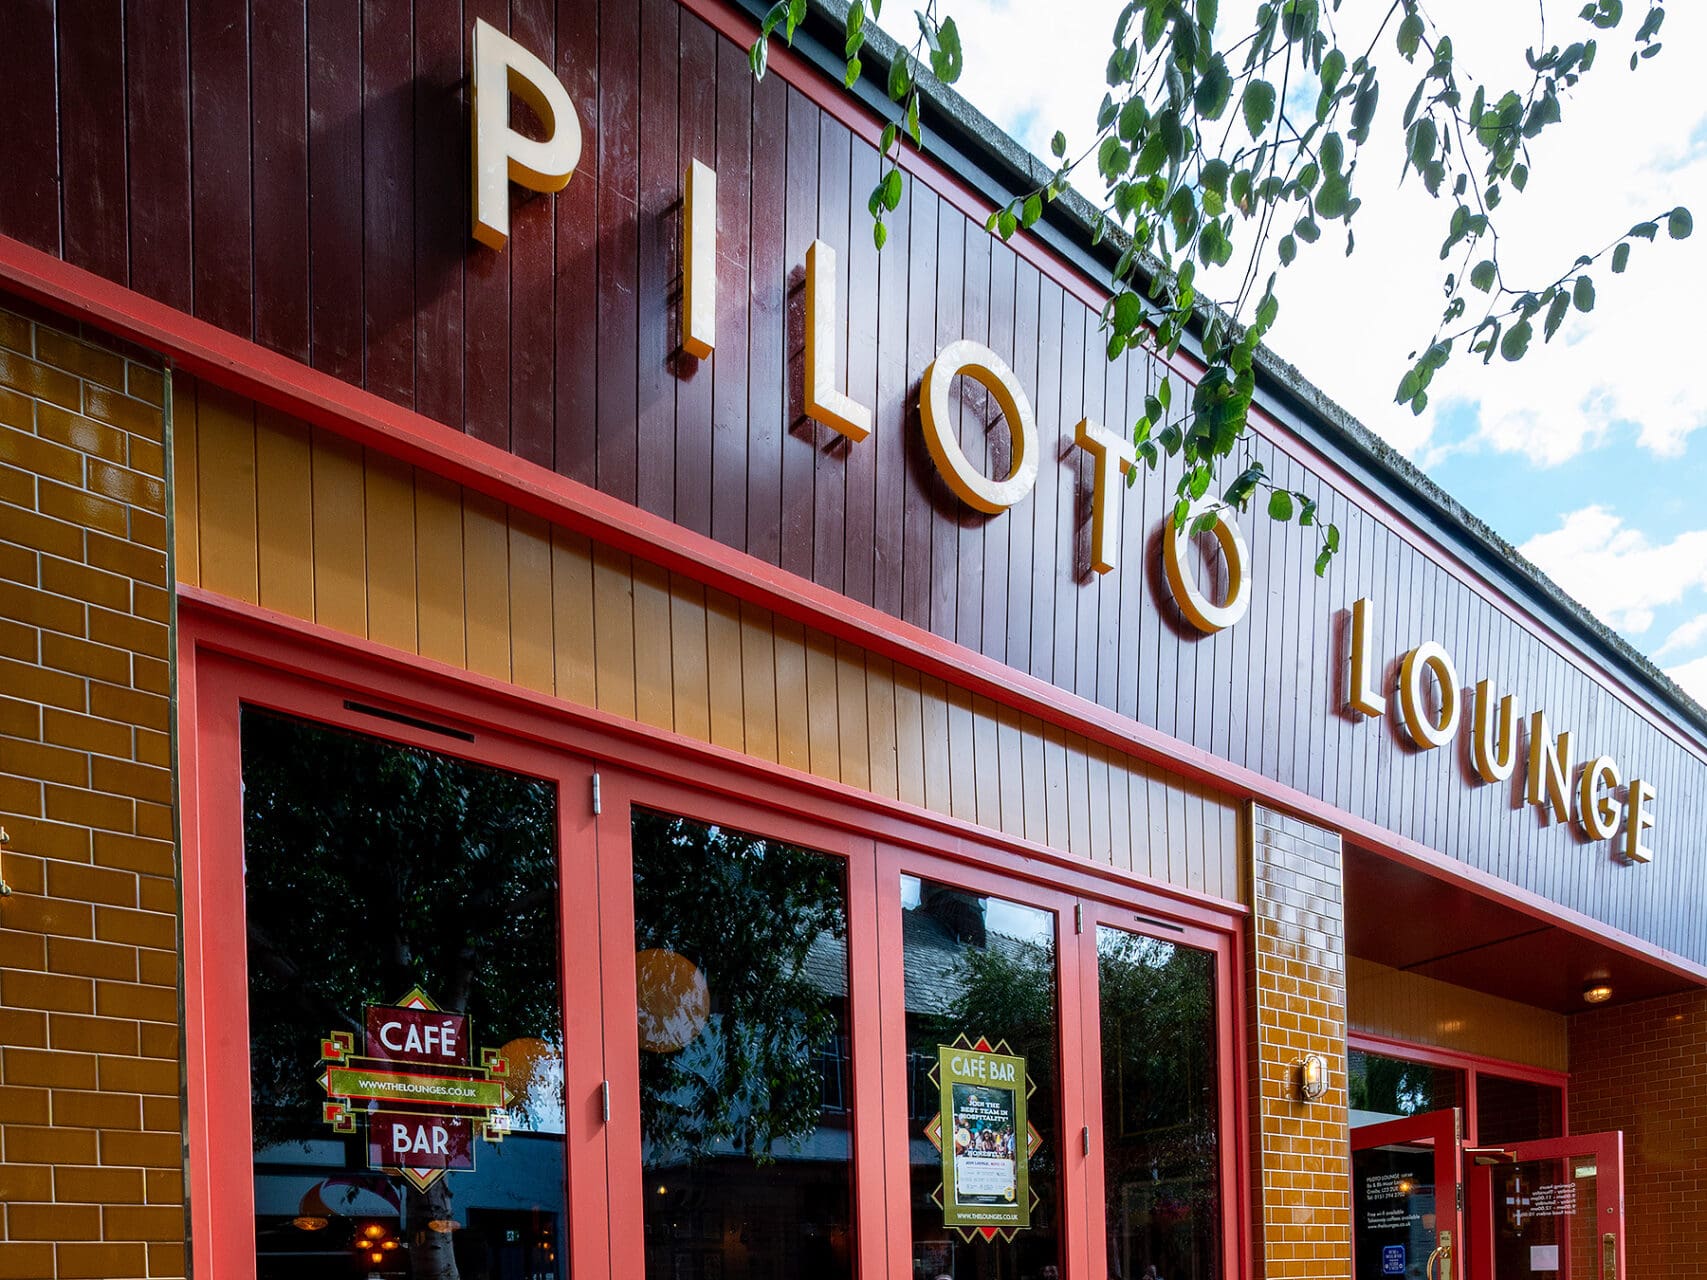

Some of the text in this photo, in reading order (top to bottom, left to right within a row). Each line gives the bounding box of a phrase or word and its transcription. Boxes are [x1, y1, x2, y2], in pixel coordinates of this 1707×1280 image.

[472, 17, 1656, 864] PILOTO LOUNGE
[379, 1019, 457, 1057] CAFÉ
[950, 1054, 1016, 1083] CAFÉ BAR
[358, 1079, 477, 1098] WWW.THELOUNGES.CO.UK
[960, 1106, 1008, 1116] BEST TEAM IN
[985, 1101, 1000, 1110] THE
[391, 1122, 450, 1155] BAR
